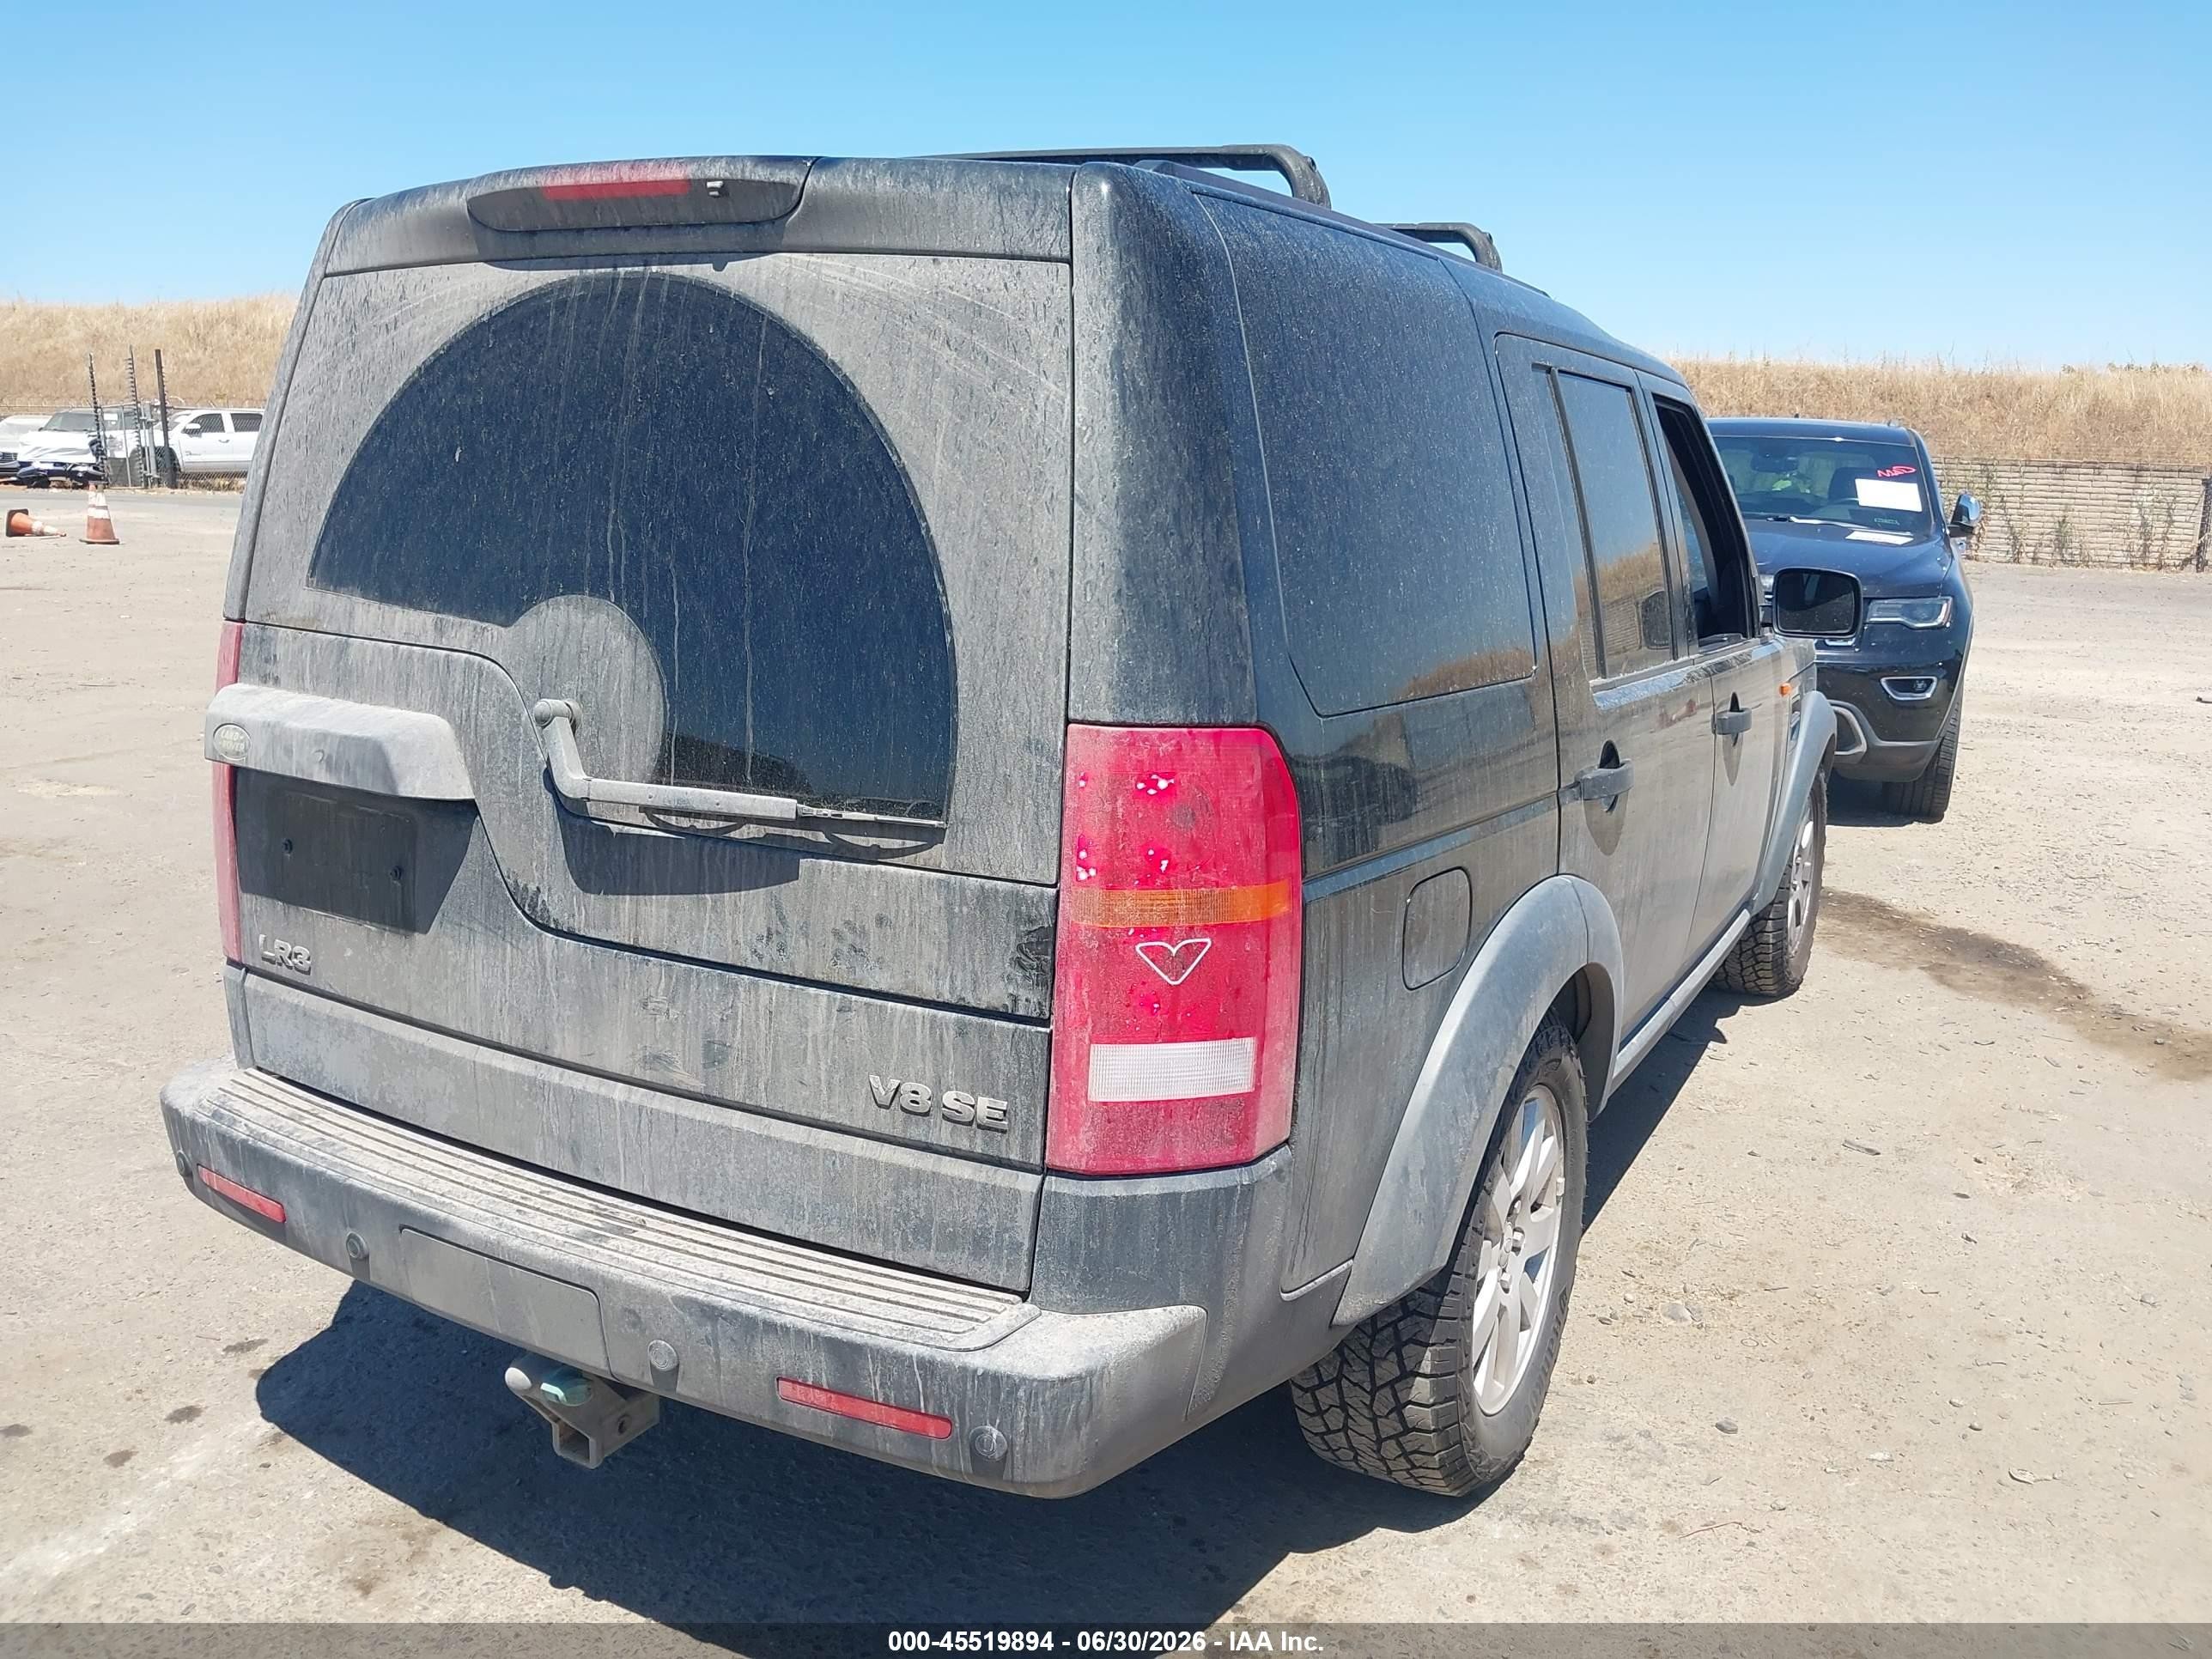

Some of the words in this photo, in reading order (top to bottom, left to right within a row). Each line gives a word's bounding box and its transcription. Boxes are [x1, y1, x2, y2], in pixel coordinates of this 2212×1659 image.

[258, 933, 312, 975] LR3
[869, 1074, 933, 1116] V8
[942, 1090, 1008, 1133] SE
